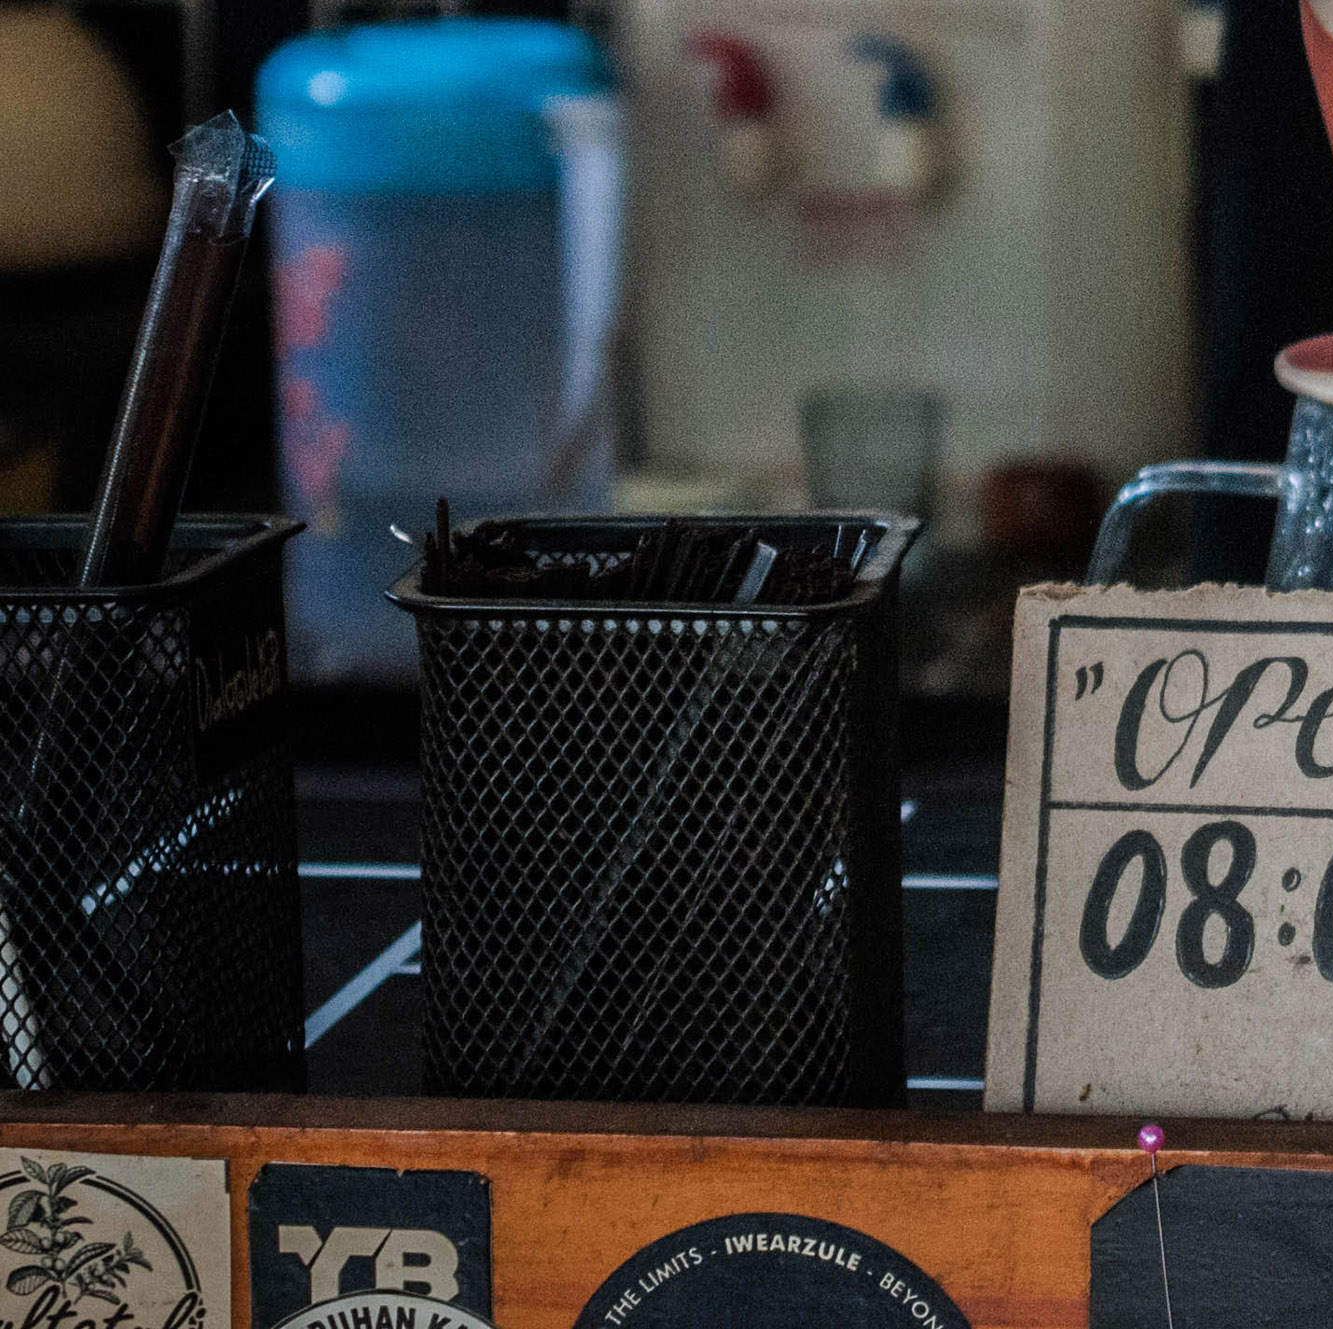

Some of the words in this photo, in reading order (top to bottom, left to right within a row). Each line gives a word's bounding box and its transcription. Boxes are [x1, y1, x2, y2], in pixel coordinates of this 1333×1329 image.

[604, 1288, 642, 1328] THE
[639, 1246, 704, 1294] LIMITS
[724, 1234, 862, 1272] IWEARZULE
